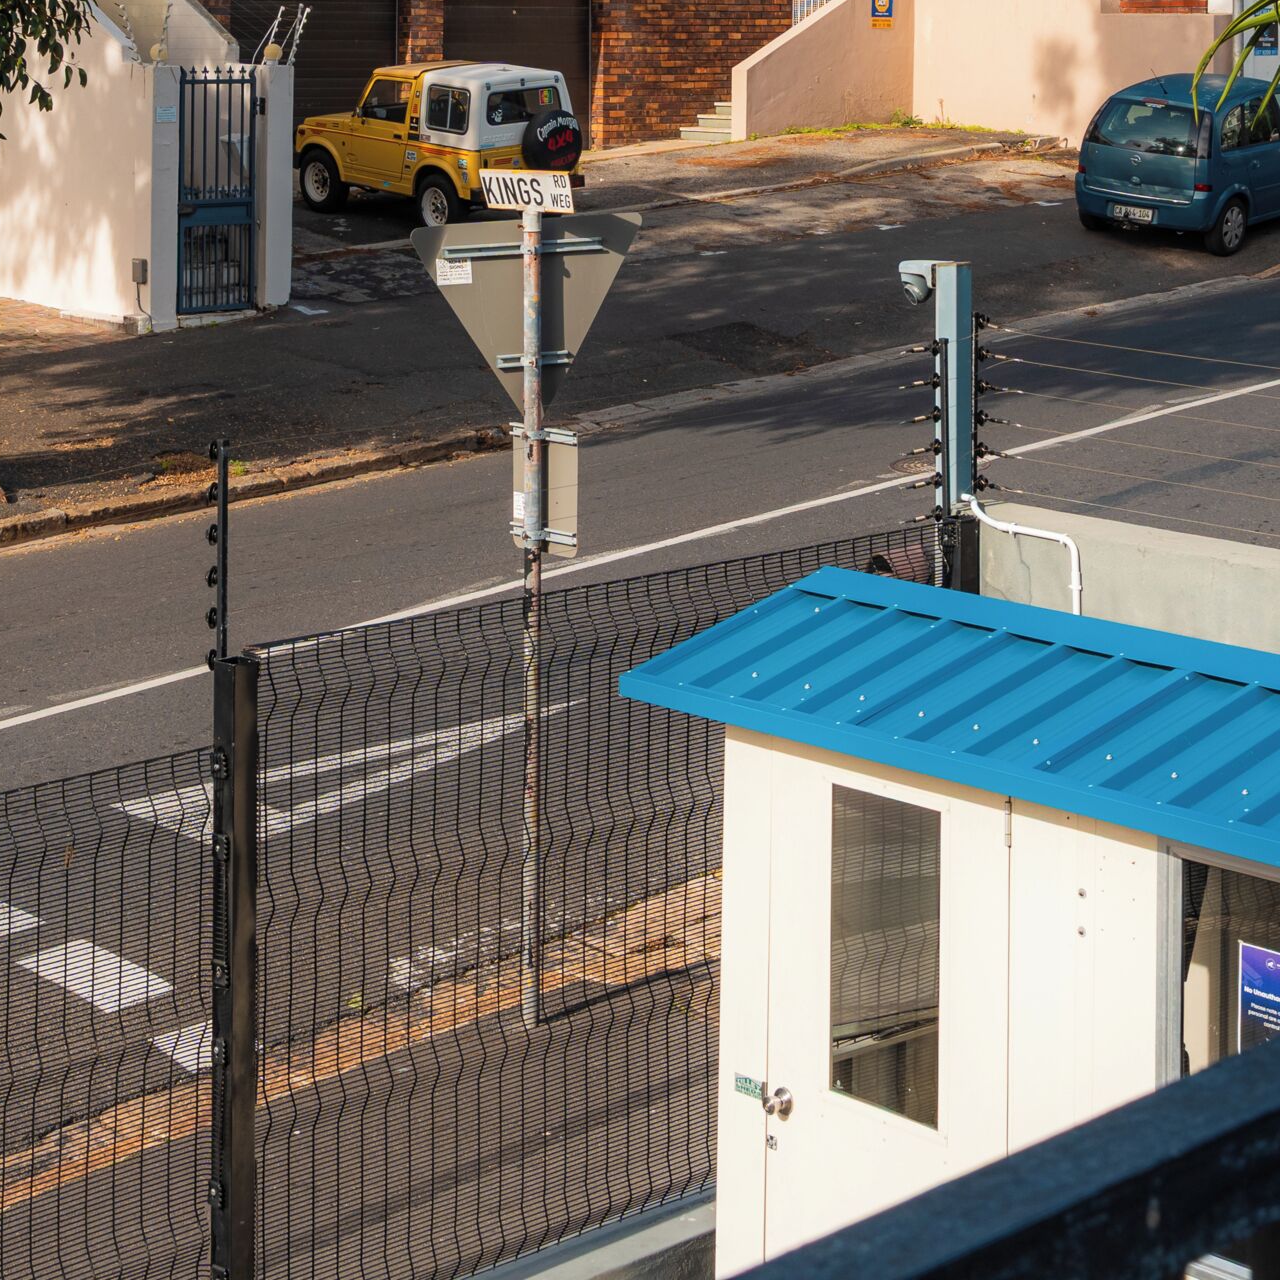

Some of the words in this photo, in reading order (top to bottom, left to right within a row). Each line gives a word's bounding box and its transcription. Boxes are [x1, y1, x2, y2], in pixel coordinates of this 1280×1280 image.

[536, 119, 558, 142] Captain
[557, 116, 580, 132] Morgan
[482, 176, 544, 206] KINGS
[552, 174, 567, 189] RD
[550, 193, 571, 208] WEG
[1244, 985, 1253, 994] No
